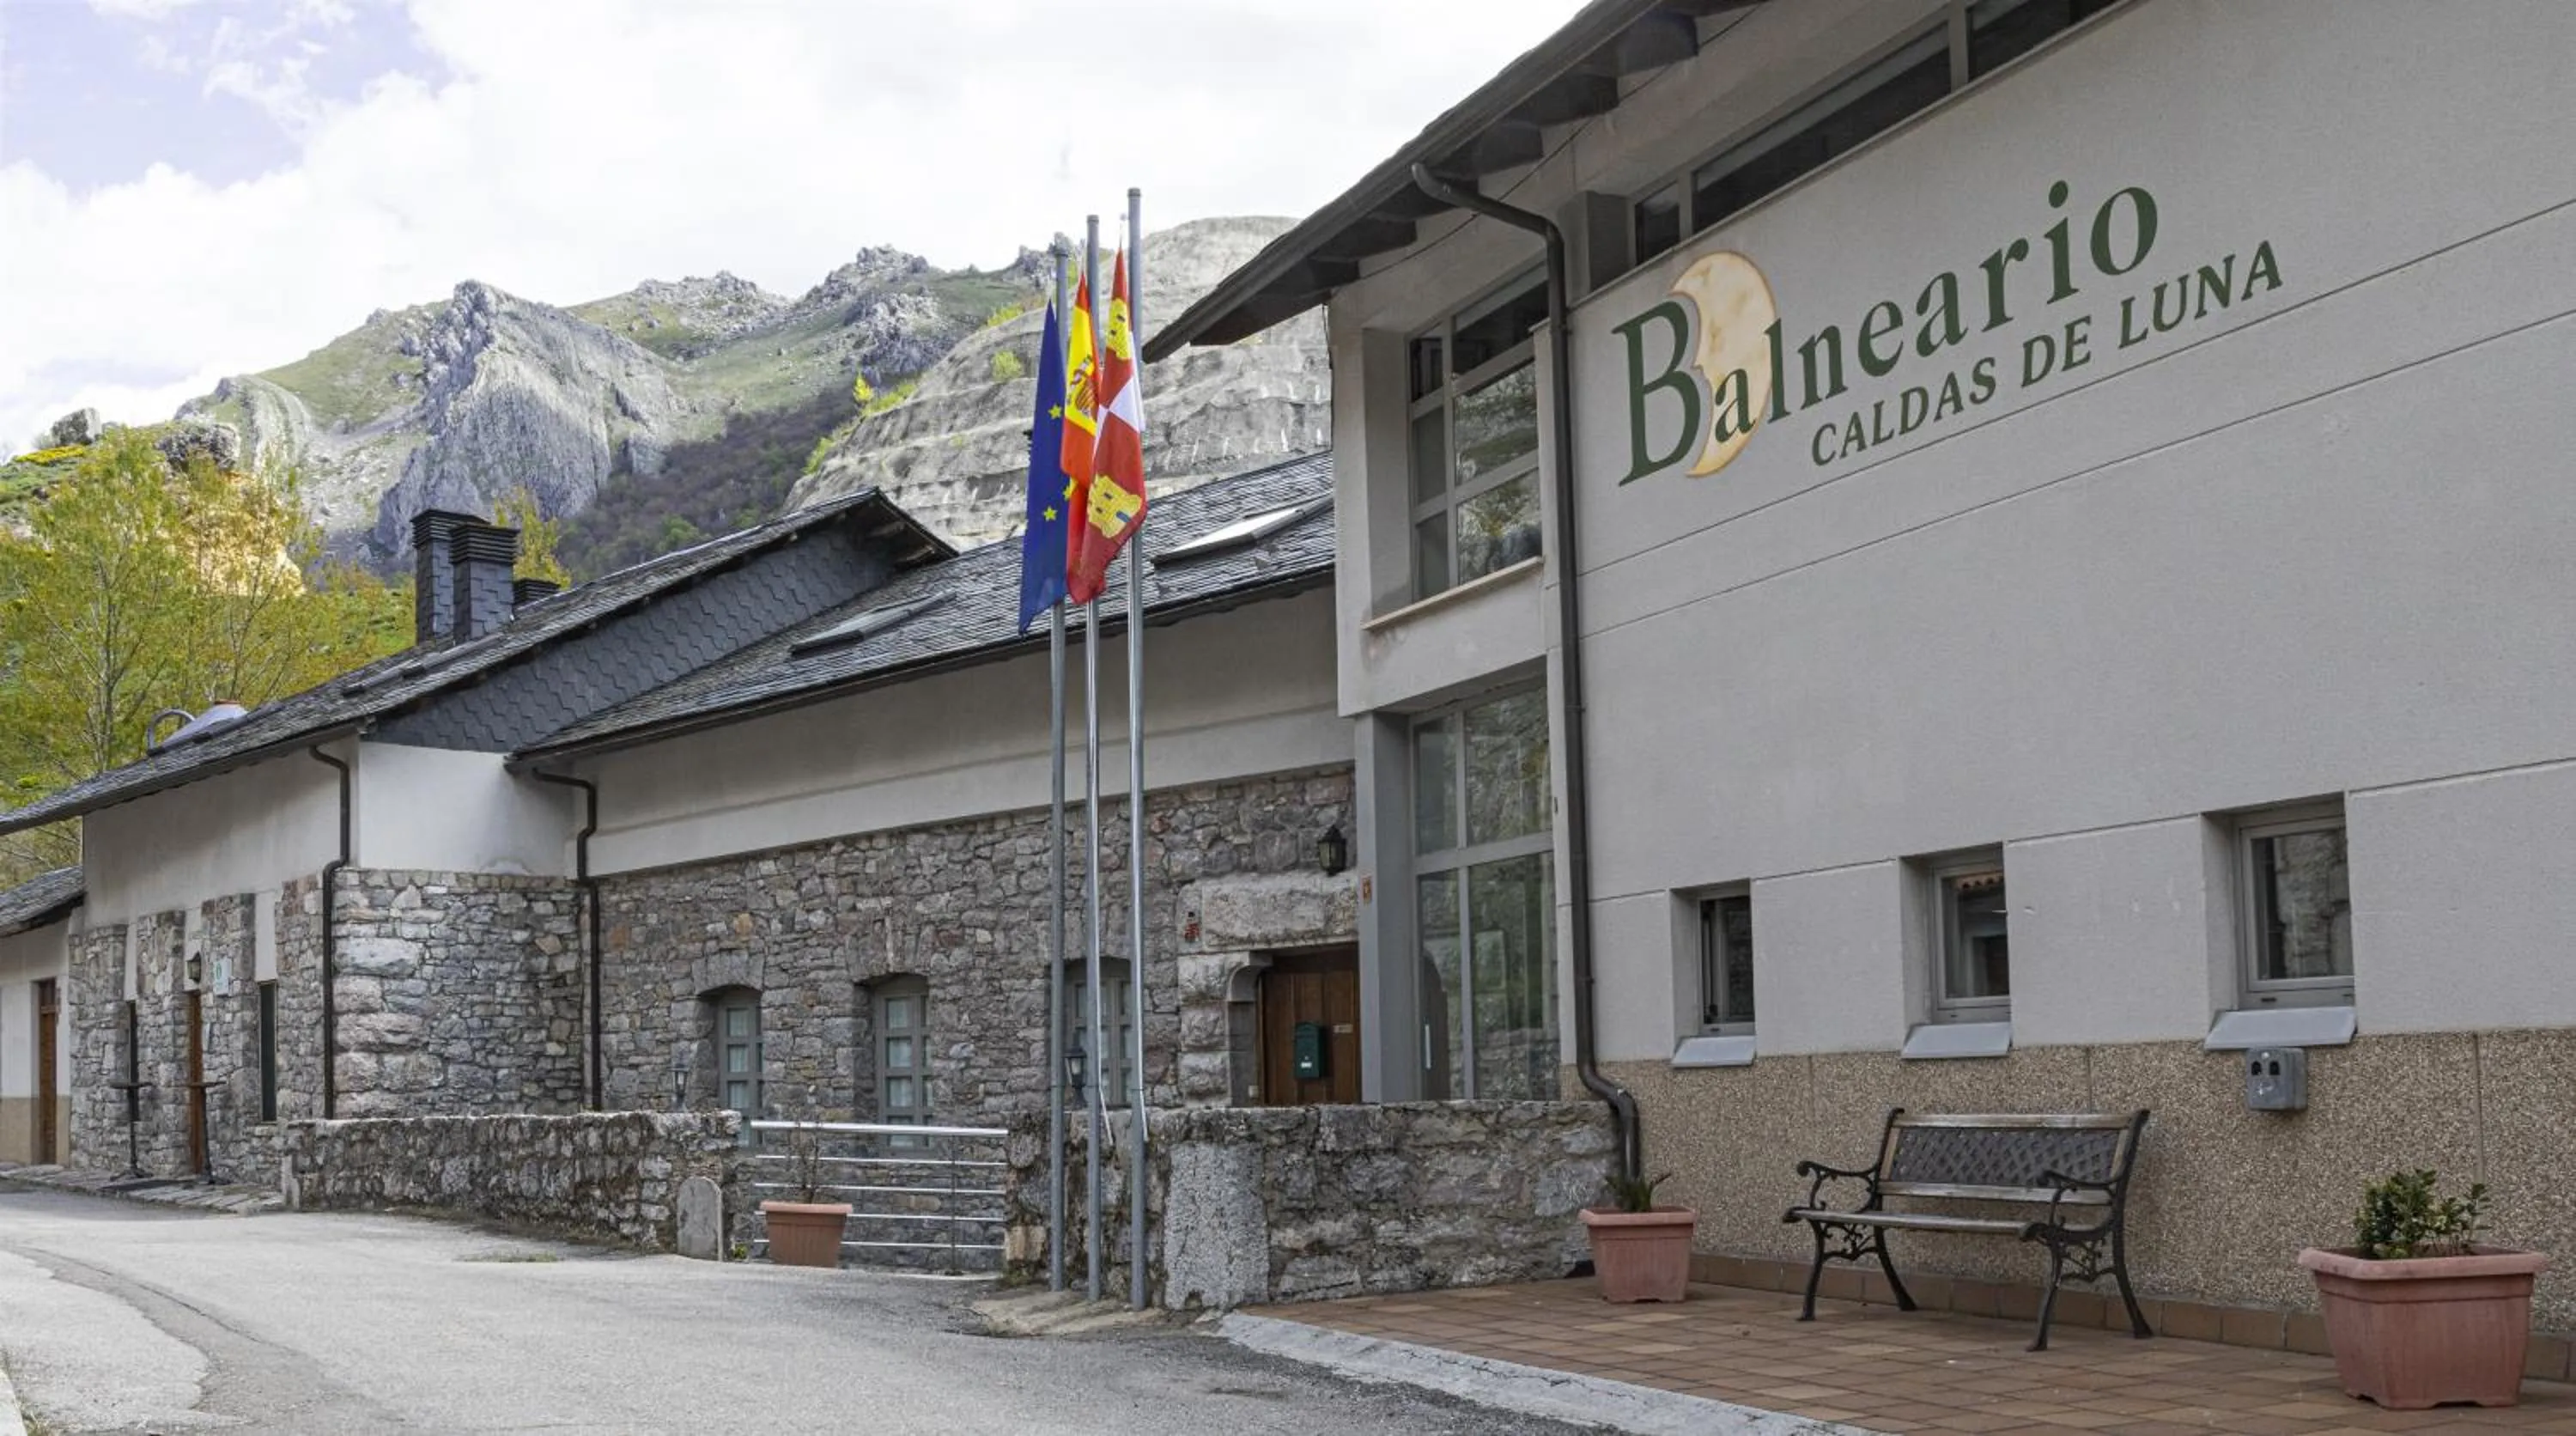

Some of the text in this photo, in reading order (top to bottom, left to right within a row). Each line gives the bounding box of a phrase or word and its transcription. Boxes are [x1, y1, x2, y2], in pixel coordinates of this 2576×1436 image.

[1611, 180, 2159, 487] Balneario
[1811, 240, 2283, 466] CALDAS DE LUNA
